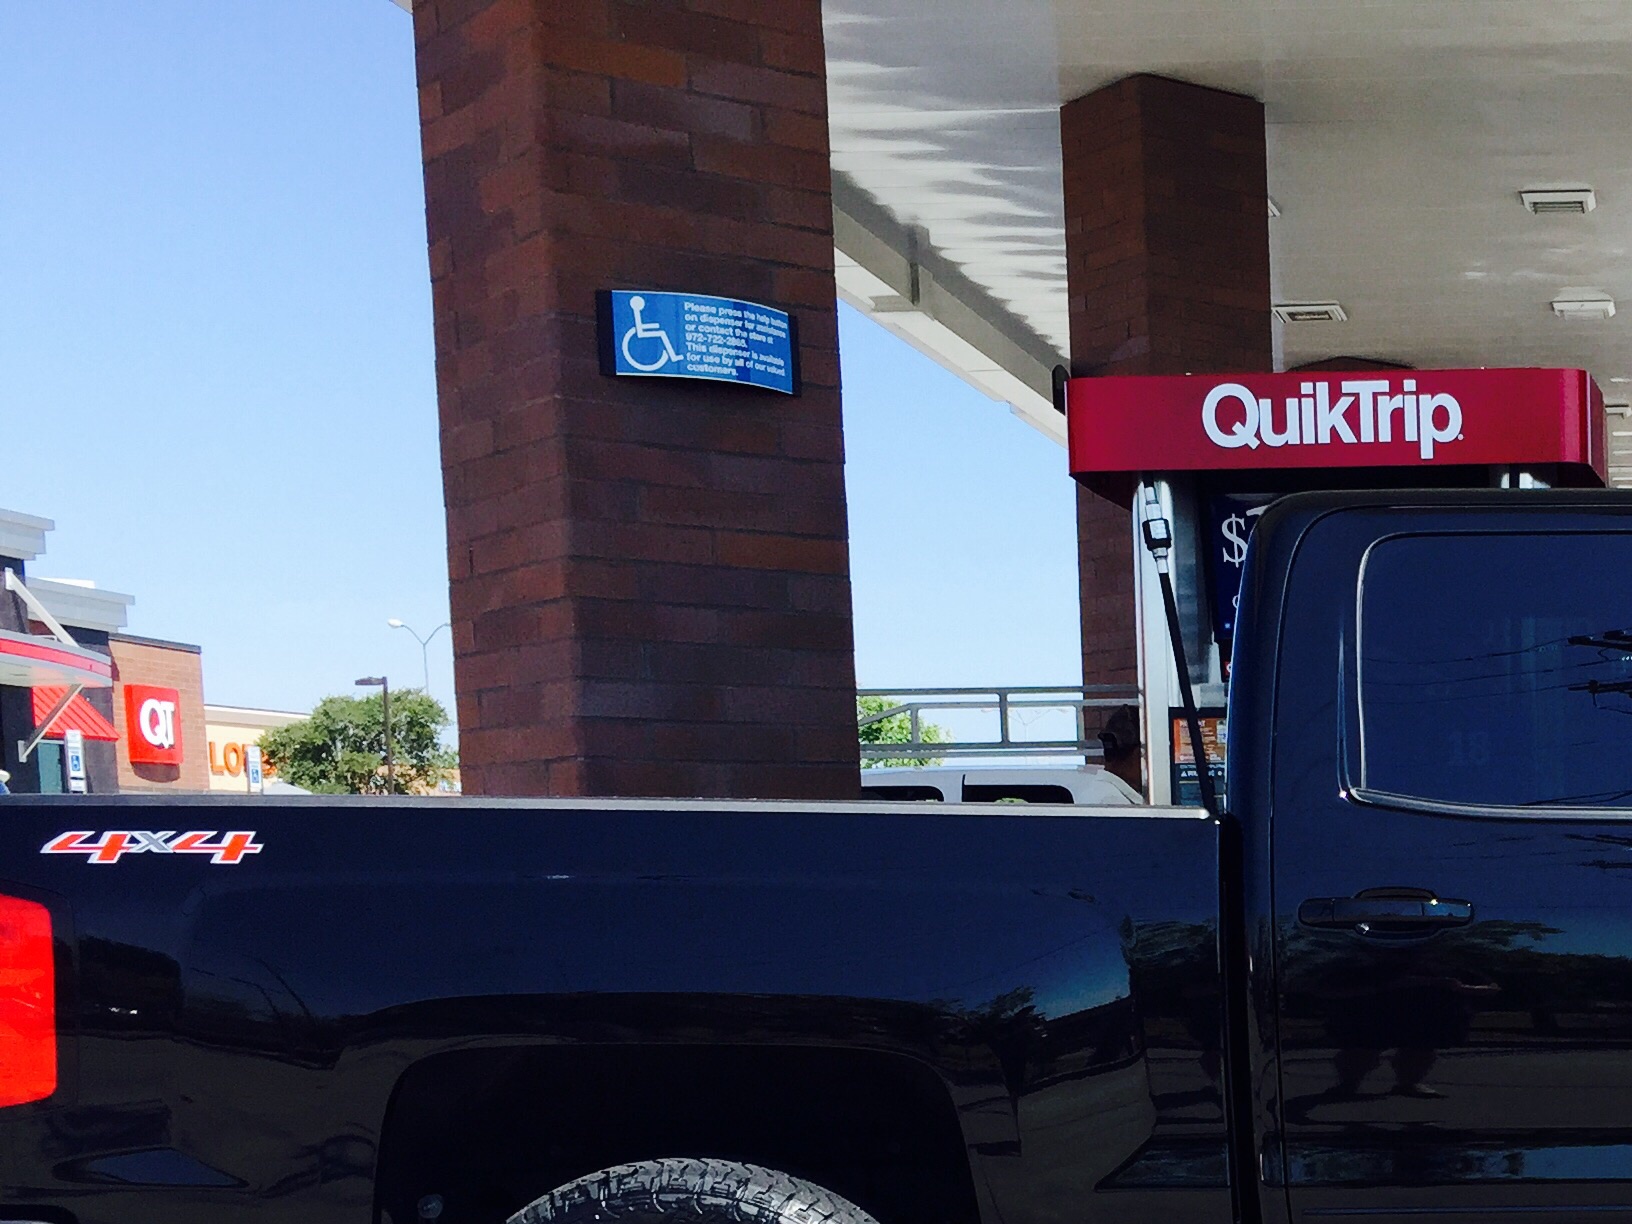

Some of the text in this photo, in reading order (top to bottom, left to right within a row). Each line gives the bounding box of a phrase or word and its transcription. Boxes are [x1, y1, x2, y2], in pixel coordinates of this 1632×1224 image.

[684, 302, 716, 314] Please
[719, 308, 742, 318] press
[744, 310, 755, 320] the
[700, 314, 743, 327] dispenser
[745, 320, 754, 329] for
[698, 324, 733, 336] contact
[735, 328, 747, 338] the
[685, 342, 706, 352] This
[709, 345, 750, 358] dispenser
[686, 352, 700, 361] for
[703, 355, 720, 364] use
[722, 356, 733, 366] by
[735, 358, 744, 367] all
[687, 363, 739, 376] customers.
[1202, 379, 1463, 459] QuikTrip
[139, 698, 176, 750] QT
